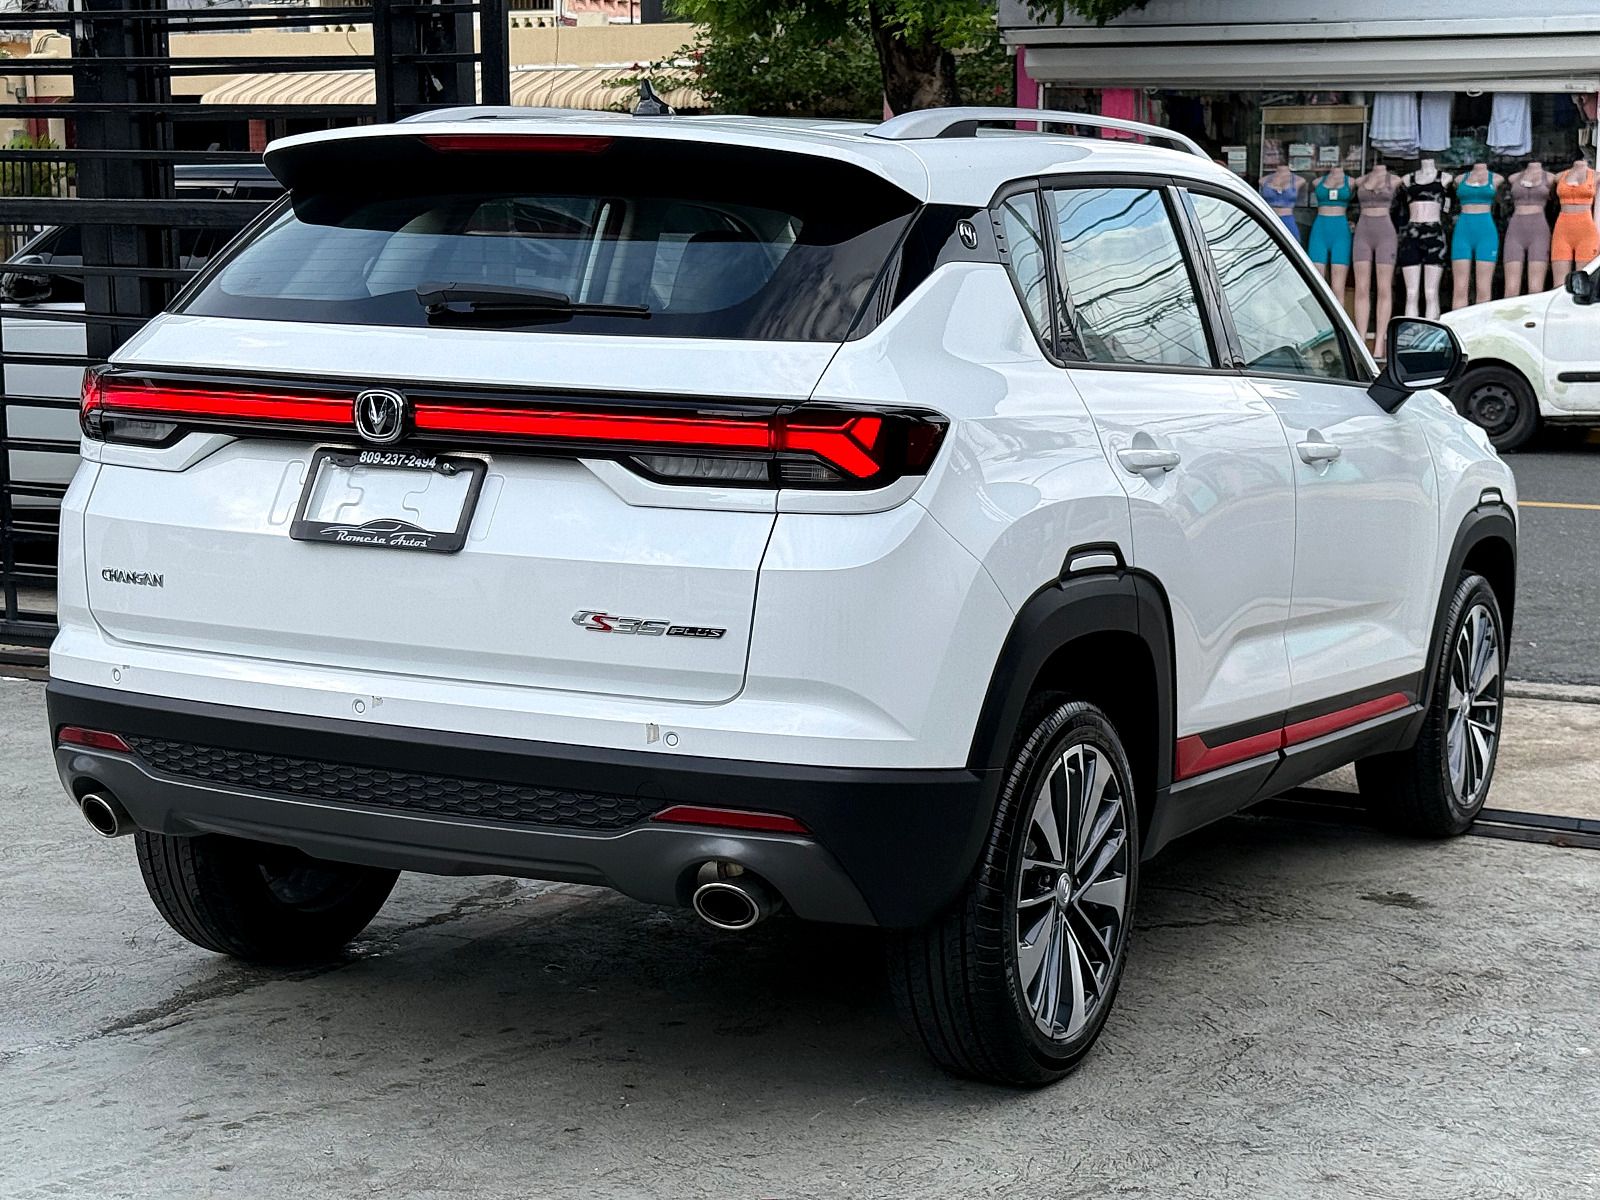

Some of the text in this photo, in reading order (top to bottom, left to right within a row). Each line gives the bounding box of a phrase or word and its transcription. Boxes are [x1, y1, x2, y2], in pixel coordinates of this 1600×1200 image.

[336, 531, 428, 547] Romesa Autos
[101, 568, 164, 588] CHANGAN
[571, 610, 725, 638] CS35 PLUS
